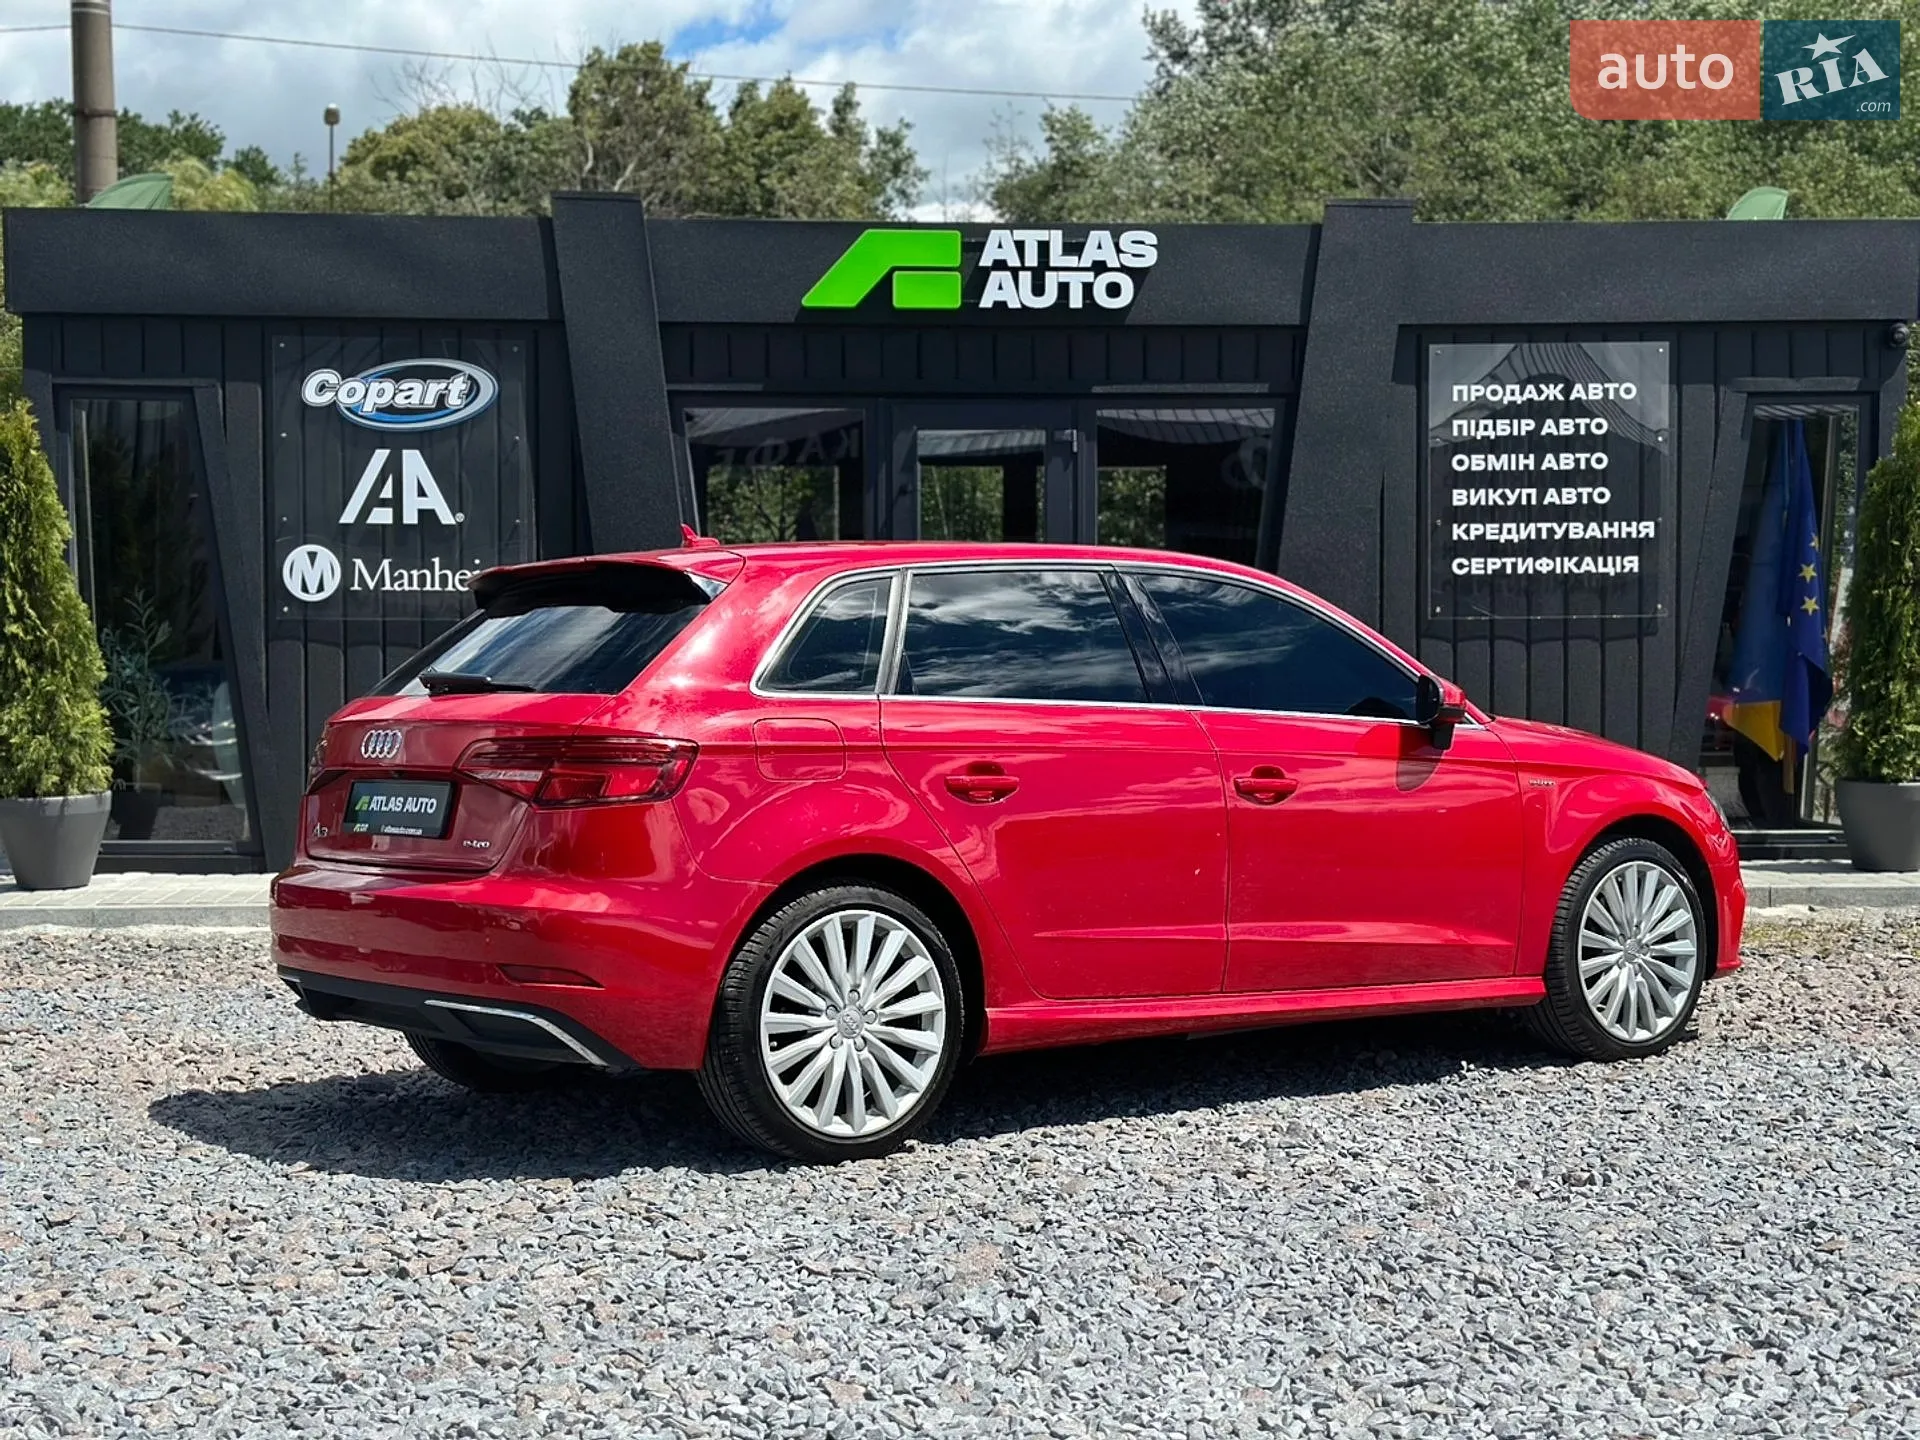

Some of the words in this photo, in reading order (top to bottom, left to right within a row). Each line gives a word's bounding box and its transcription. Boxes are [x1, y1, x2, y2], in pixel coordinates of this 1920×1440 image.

[978, 229, 1159, 268] ATLAS
[978, 270, 1135, 309] AUTO
[301, 368, 471, 416] Copart
[1451, 383, 1565, 405] ПРОДАЖ
[1569, 382, 1638, 402] АВТО
[1451, 418, 1536, 440] ПІДБІР
[1540, 417, 1609, 437] АВТО
[1451, 453, 1535, 472] ОБМІН
[1540, 452, 1609, 471] АВТО
[1451, 488, 1538, 507] ВИКУП
[1542, 487, 1611, 505] АВТО
[1451, 521, 1656, 543] КРЕДИТУВАННЯ
[350, 556, 481, 592] Manhe
[1451, 555, 1640, 576] СЕРТИФІКАЦІЯ
[368, 795, 404, 812] ATLAS
[403, 797, 437, 814] AUTO
